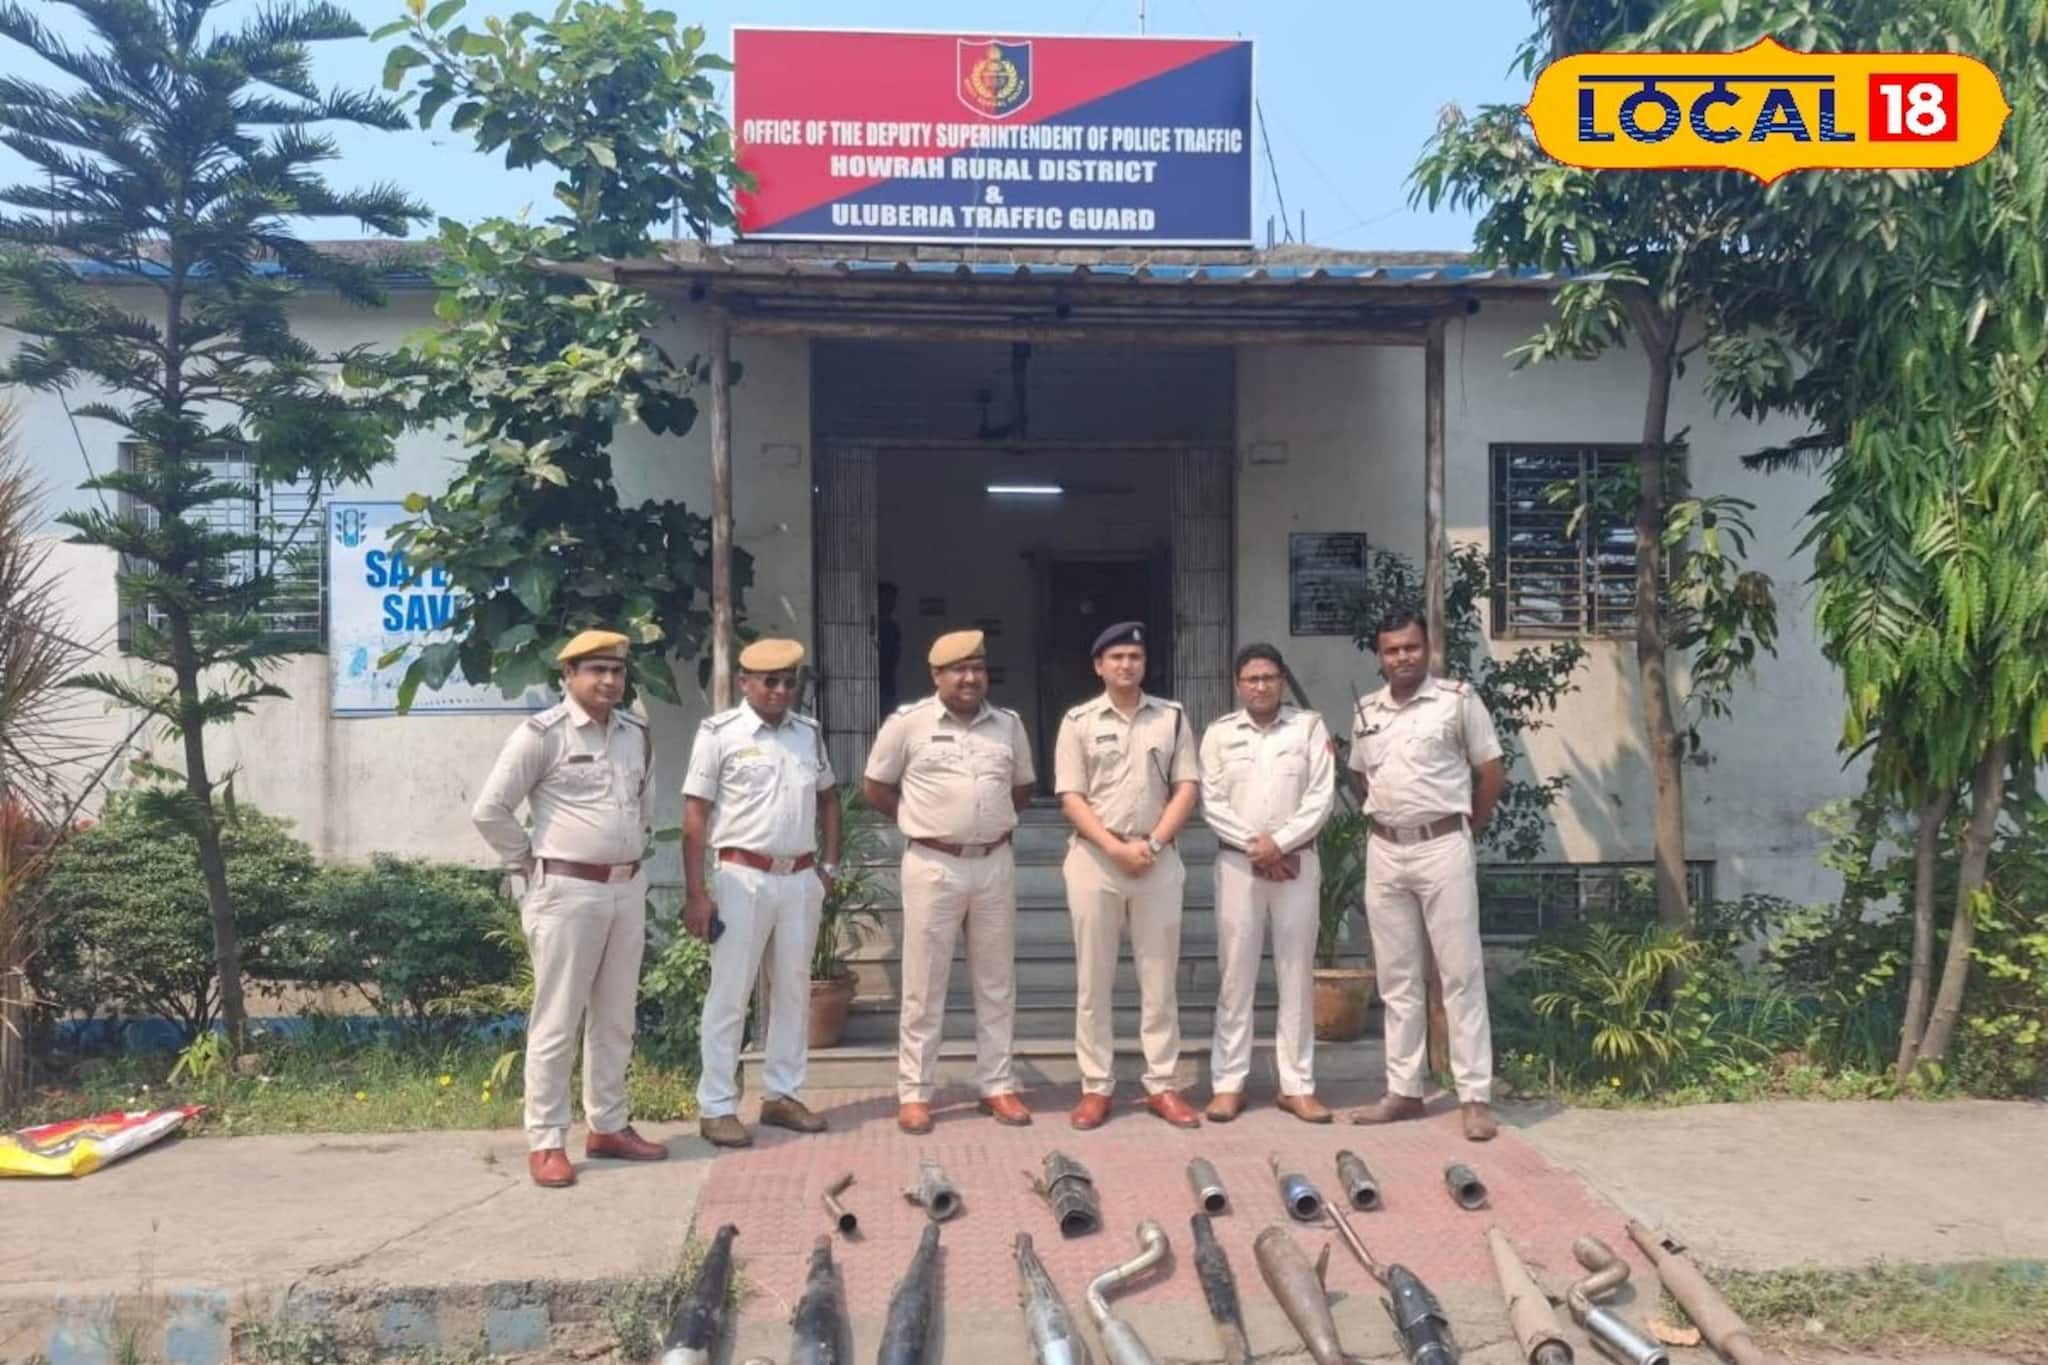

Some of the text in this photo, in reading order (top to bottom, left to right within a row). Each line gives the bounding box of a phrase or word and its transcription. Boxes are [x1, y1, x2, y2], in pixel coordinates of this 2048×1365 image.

[743, 119, 1243, 153] OFFICE OF THE DEPUTY SUPERINTENDENT OF POLICE TRAFFIC
[830, 155, 1157, 182] HOWRAH RURAL DISTRICT
[985, 185, 1004, 204] &
[832, 203, 1156, 231] ULUBERIA TRAFFIC GUARD
[383, 593, 453, 631] SAV
